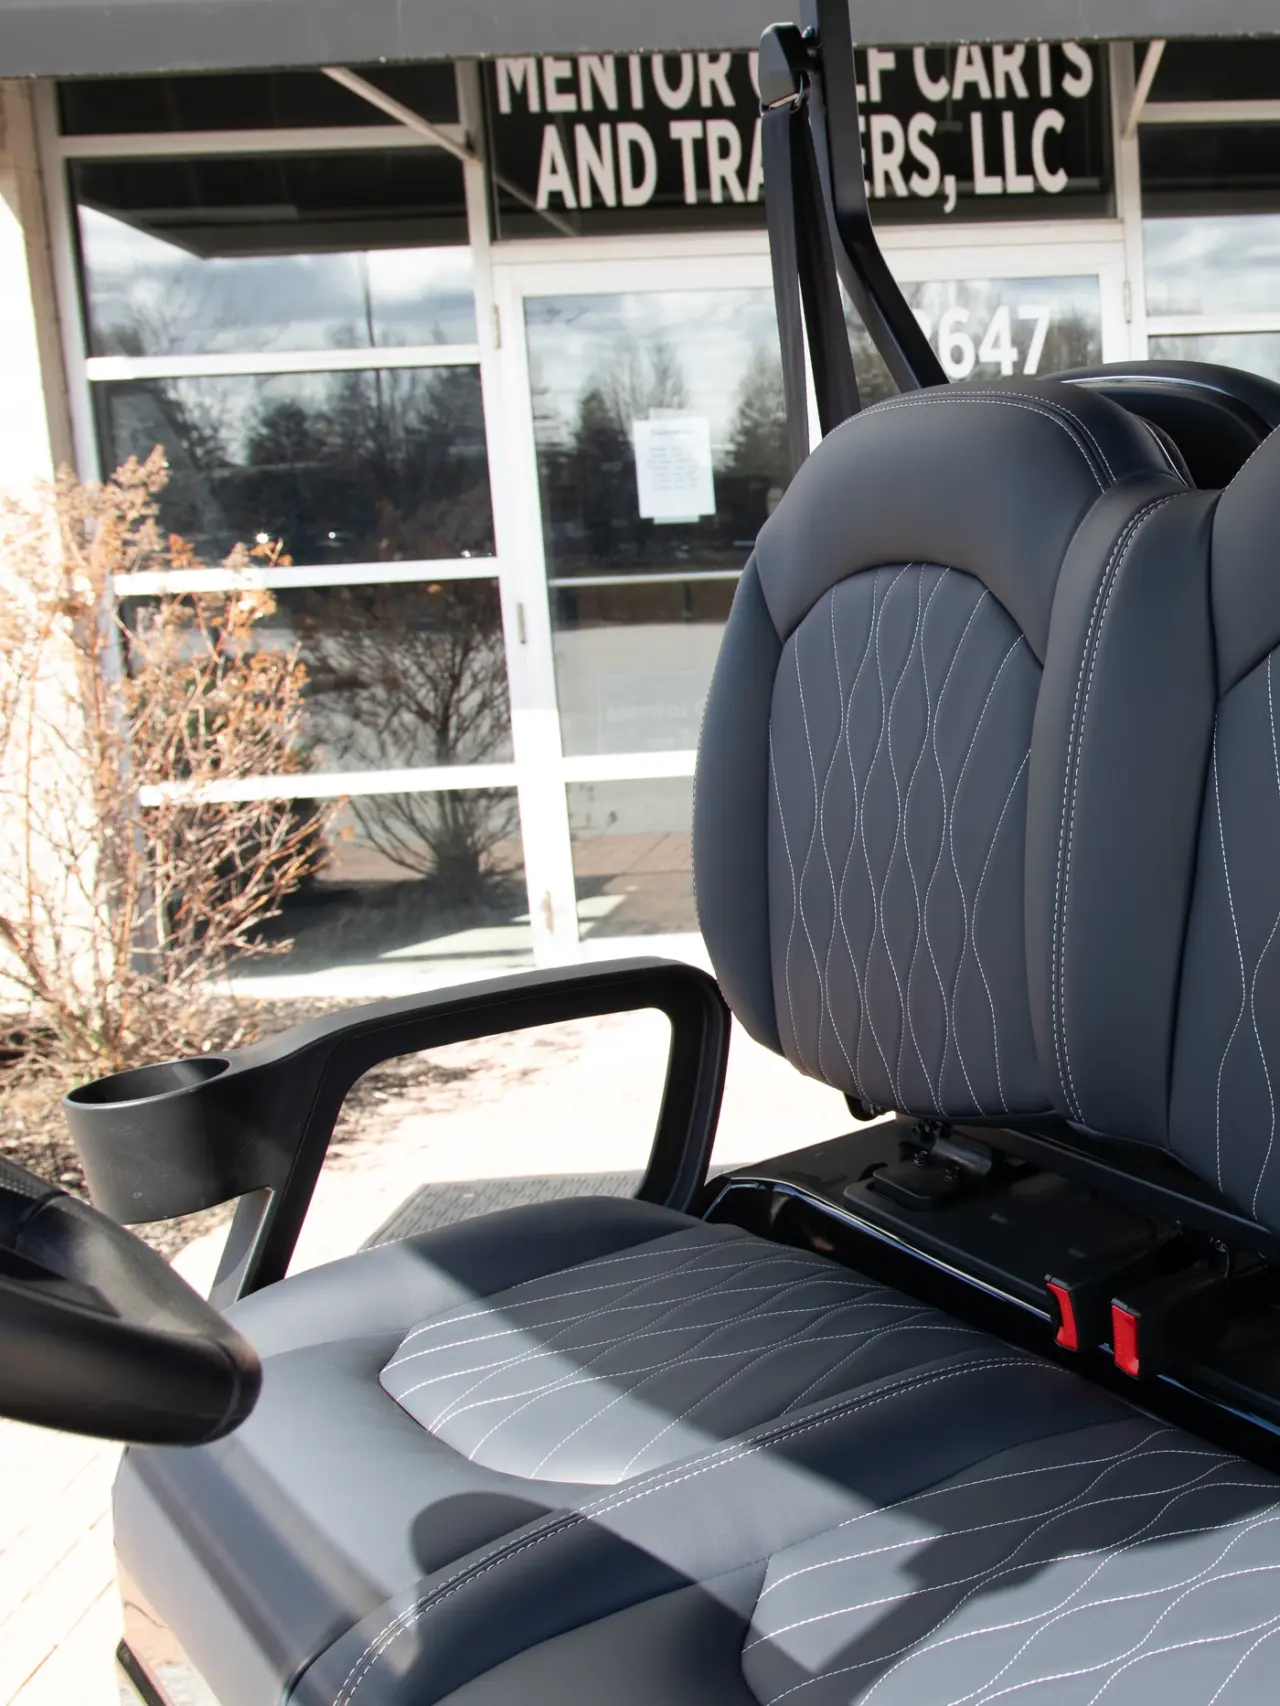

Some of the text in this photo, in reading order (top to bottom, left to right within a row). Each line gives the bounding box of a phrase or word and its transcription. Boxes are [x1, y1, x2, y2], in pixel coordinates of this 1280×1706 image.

[535, 121, 658, 210] AND
[970, 108, 1068, 195] LLC
[911, 304, 1050, 380] 647
